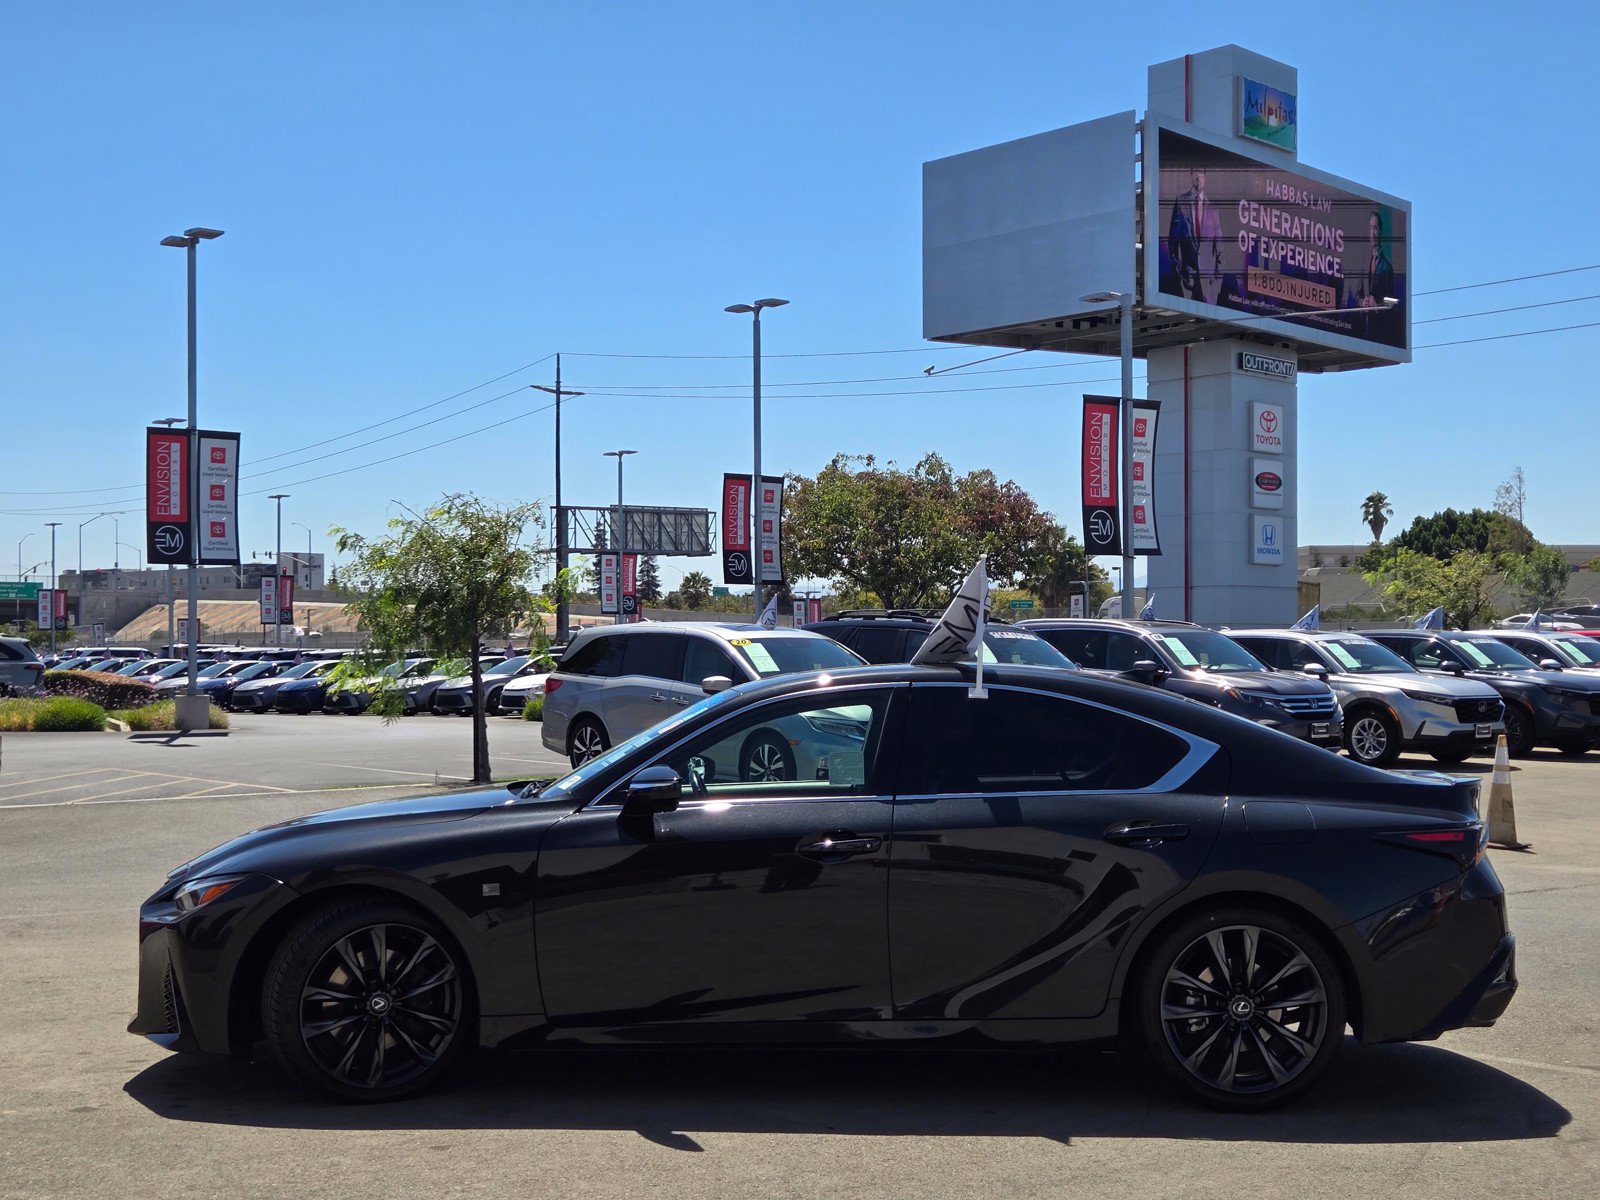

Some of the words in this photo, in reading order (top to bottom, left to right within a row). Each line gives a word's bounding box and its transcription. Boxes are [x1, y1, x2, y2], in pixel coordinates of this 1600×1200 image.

[1245, 88, 1293, 128] Milpitas
[1266, 179, 1308, 207] HABBAS
[1310, 194, 1332, 213] LAW
[1238, 199, 1344, 253] GENERATIONS
[1238, 229, 1257, 253] OF
[1260, 236, 1345, 279] EXPERIENCE.
[1253, 273, 1331, 305] 1.800.INJURED
[1090, 412, 1102, 498] ENVISION
[1256, 434, 1281, 446] TOYOTA
[157, 441, 170, 515] ENVISION
[729, 485, 738, 545] ENVISION
[1256, 547, 1281, 556] HONDA
